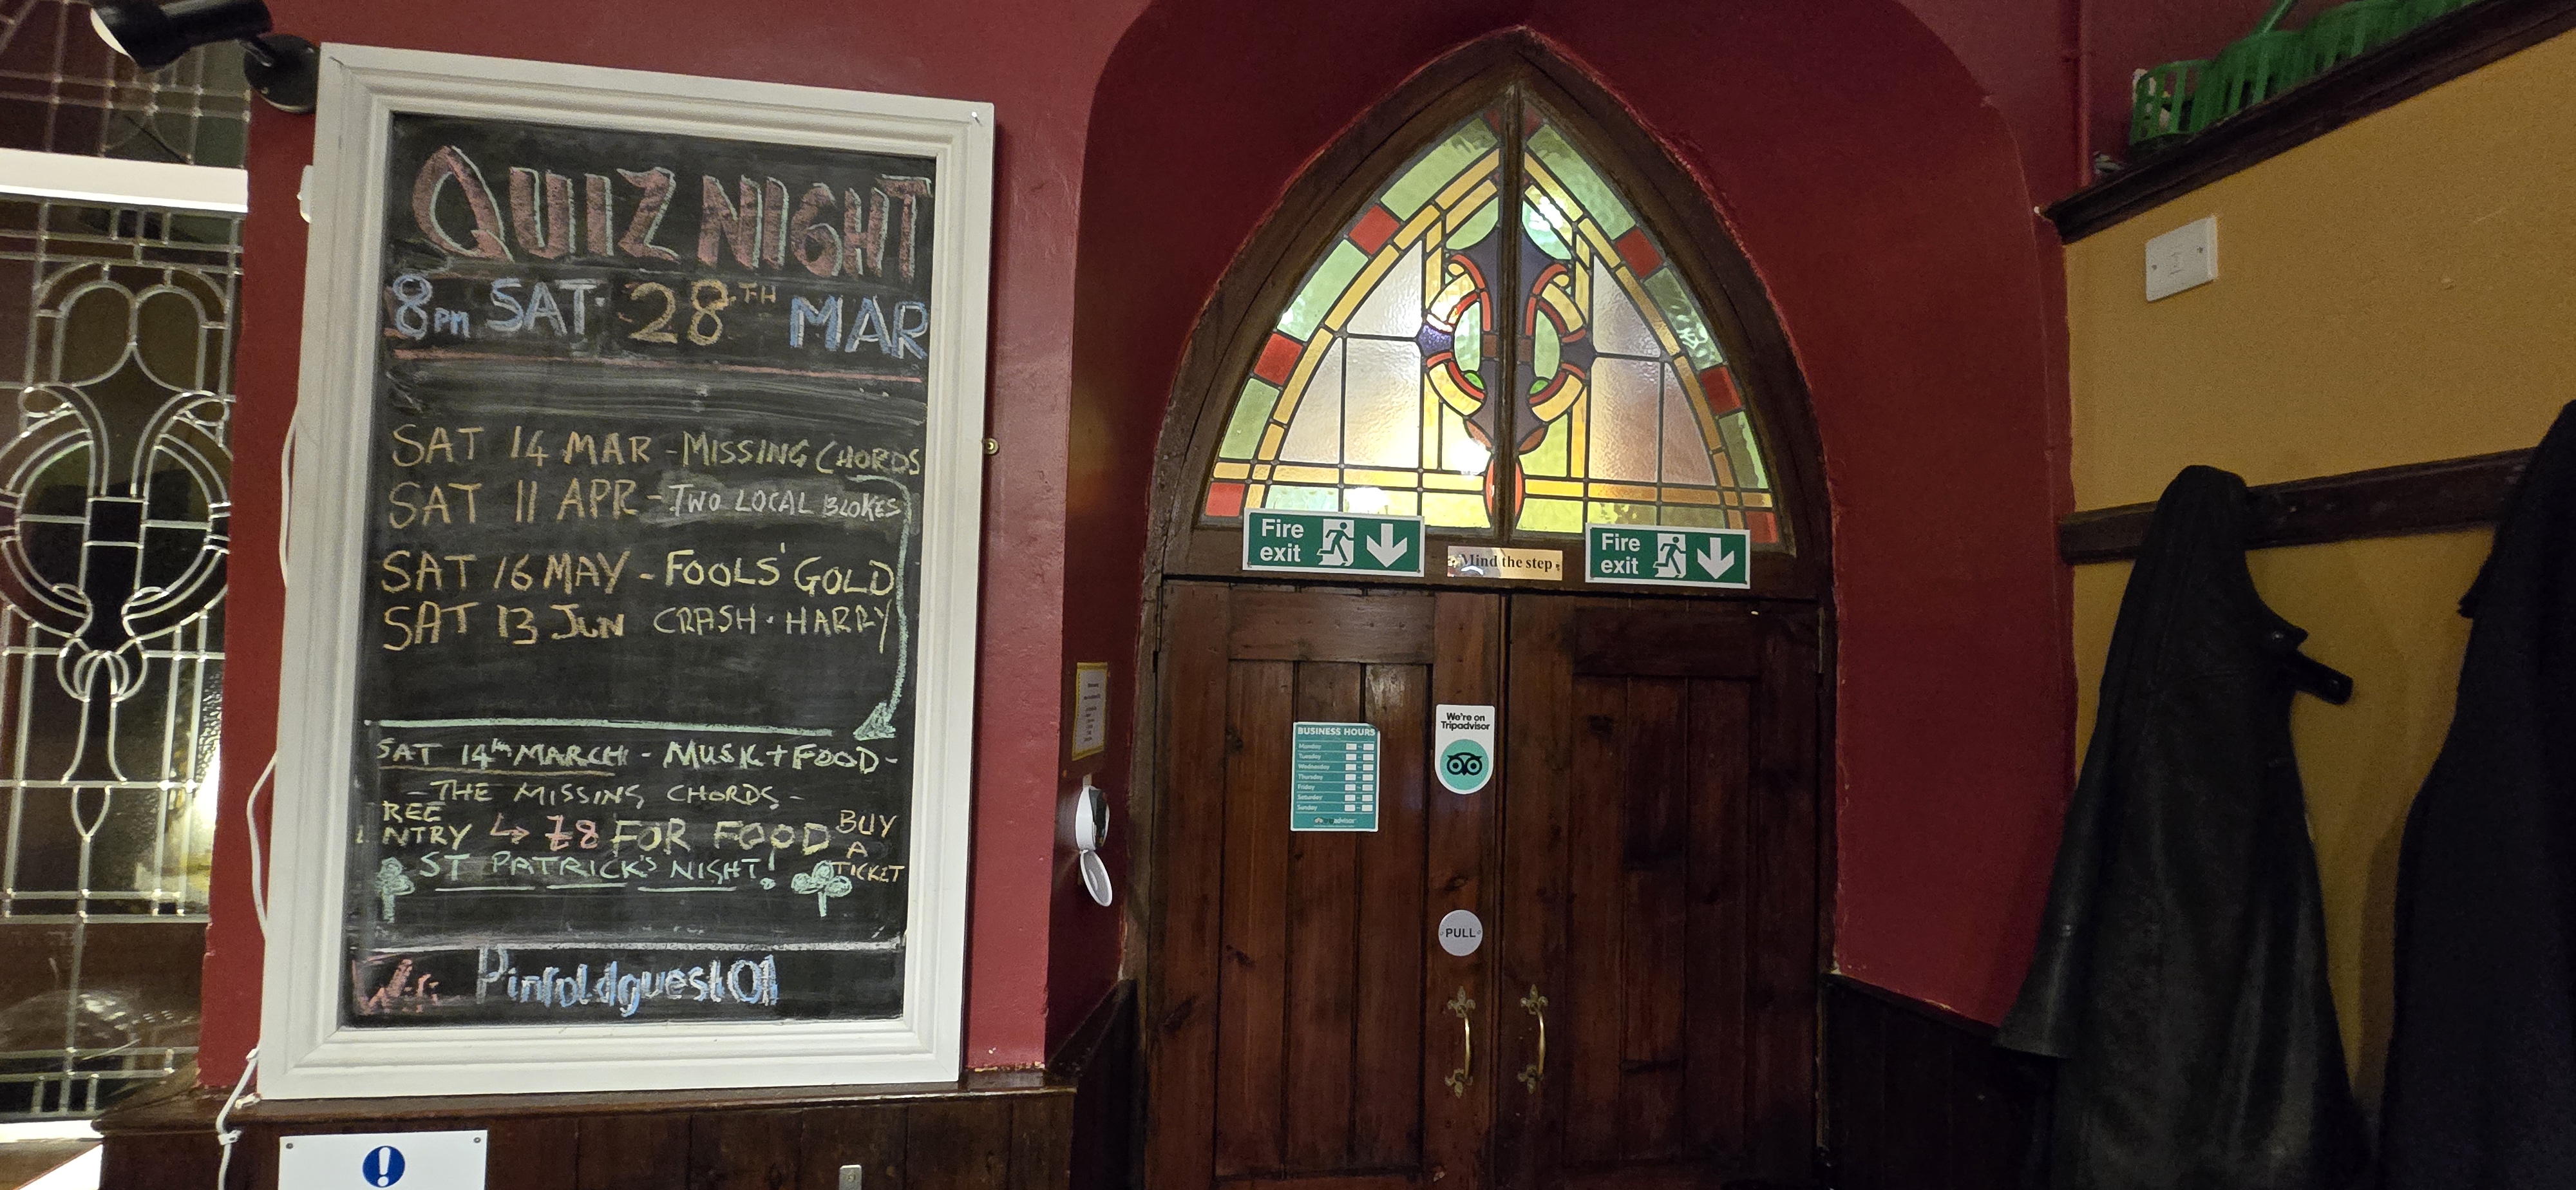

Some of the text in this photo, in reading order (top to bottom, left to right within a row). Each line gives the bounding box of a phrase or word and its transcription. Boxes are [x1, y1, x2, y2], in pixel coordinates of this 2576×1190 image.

[412, 146, 932, 284] QUIZ NIGHT
[790, 294, 928, 359] MAR
[392, 424, 484, 467] SAT
[510, 426, 549, 467] 14
[562, 431, 652, 466] MAR
[815, 440, 920, 475] CHORDS
[388, 482, 482, 529] SAT
[516, 479, 537, 524] 11
[556, 478, 638, 521] APR
[668, 483, 721, 517] TWO
[734, 489, 814, 516] LOCAL
[823, 493, 902, 522] BLOKES
[1262, 518, 1304, 538] Fire
[1260, 543, 1301, 562] exit
[1602, 533, 1640, 552] Fire
[381, 550, 477, 594] SAT
[493, 553, 533, 591] 16
[542, 550, 630, 596] MAY
[793, 556, 895, 597] GOLD
[1459, 554, 1553, 572] Mind the step
[1601, 556, 1639, 574] exit
[383, 600, 481, 651] SAT
[497, 604, 538, 645] 13
[652, 603, 757, 635] CRASH
[786, 599, 893, 654] HARRY
[1441, 721, 1490, 731] Tripadvisor
[1446, 712, 1472, 721] We're
[1298, 727, 1376, 736] BUSINESS HOURS
[377, 737, 443, 766] SAT
[513, 744, 629, 767] MARCH
[430, 779, 493, 801] THE
[667, 783, 780, 809] CHORDS
[836, 809, 897, 838] BUY
[611, 817, 691, 857] FOR
[714, 820, 831, 855] FOOD
[847, 842, 868, 859] A
[419, 851, 470, 881] ST
[491, 851, 657, 879] PATRICK'S
[831, 862, 905, 883] TICKET
[1445, 928, 1476, 938] PULL
